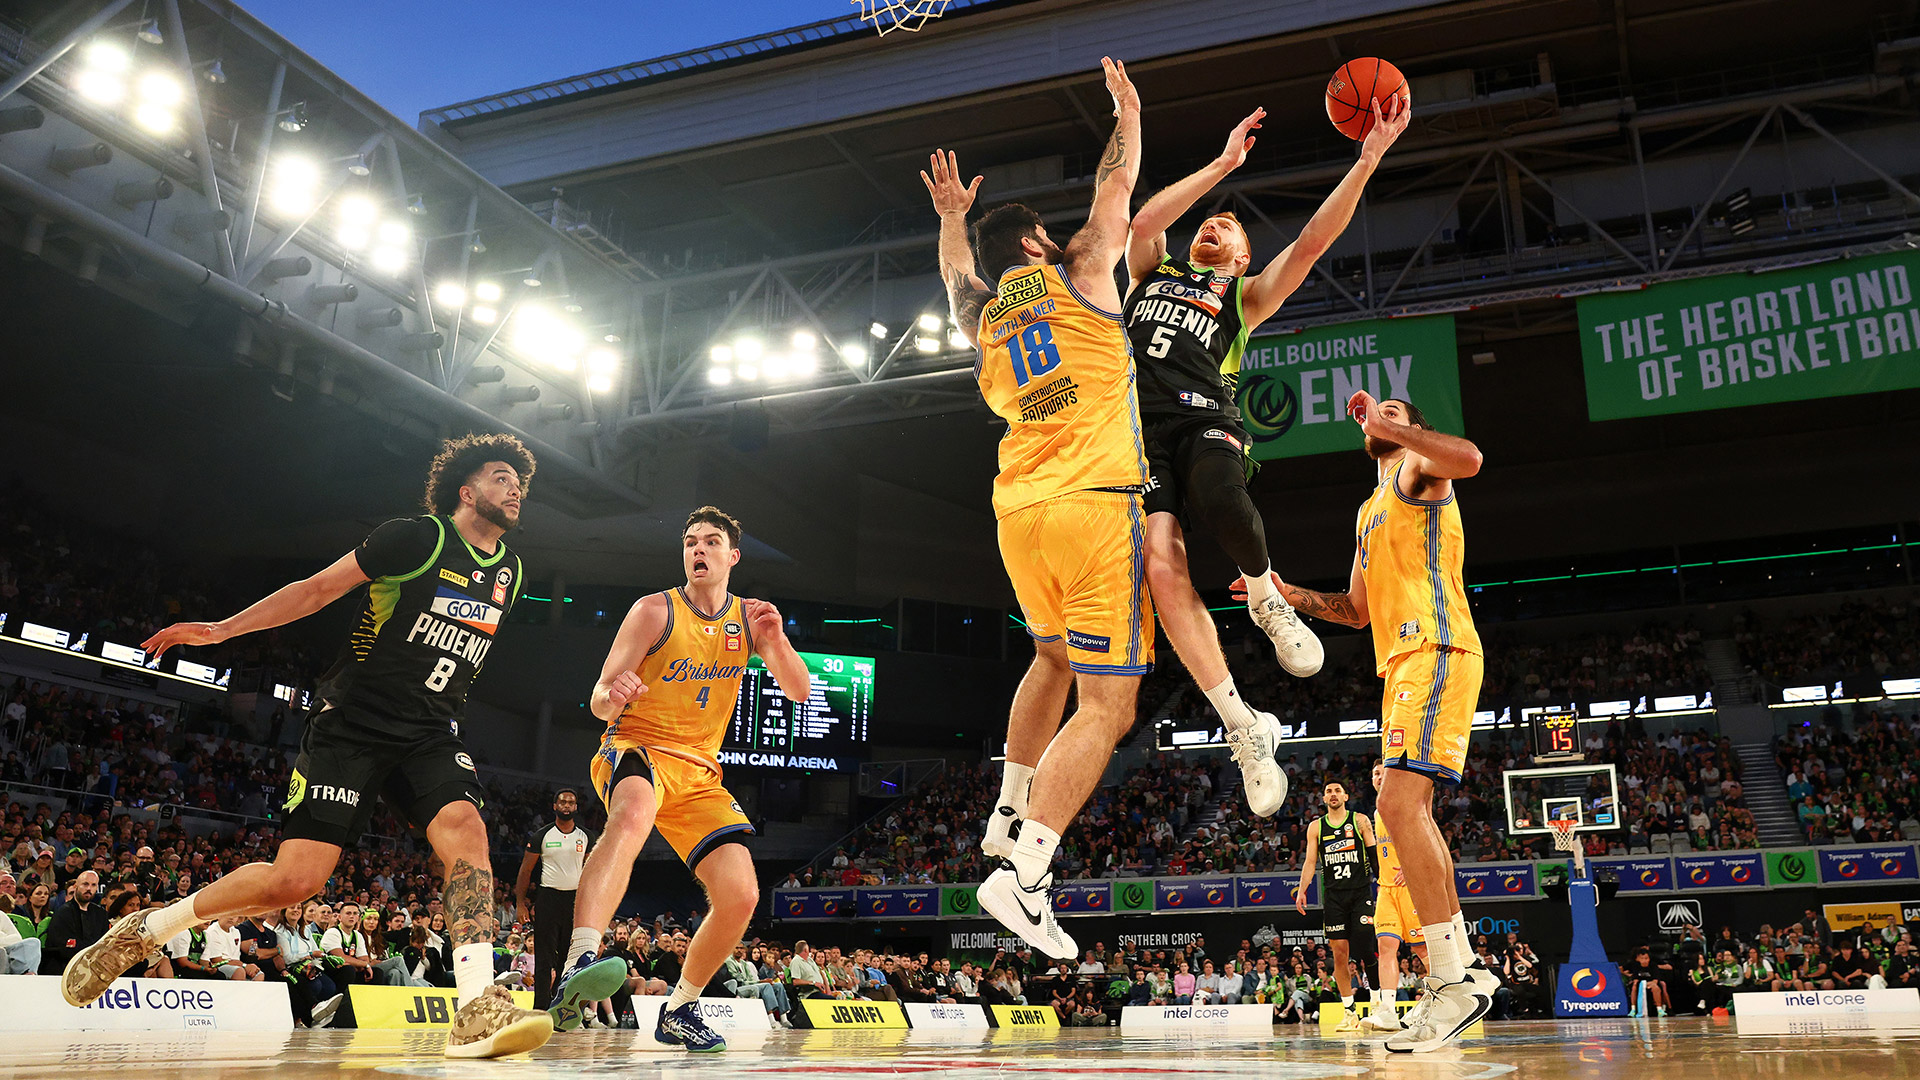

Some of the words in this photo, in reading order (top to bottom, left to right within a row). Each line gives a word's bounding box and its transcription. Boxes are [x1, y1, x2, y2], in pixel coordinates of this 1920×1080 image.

[1000, 275, 1041, 296] IONAL
[1158, 282, 1208, 299] GOAT
[989, 286, 1041, 316] STORAGE
[992, 298, 1057, 342] SMITH-MILNER
[1594, 313, 1668, 363] THE
[1680, 265, 1912, 347] HEARTLAND
[1128, 300, 1220, 350] PHOENIX
[1147, 326, 1177, 359] 5
[1006, 321, 1062, 389] 18
[1241, 334, 1378, 371] MELBOURNE
[1638, 354, 1683, 401] OF
[1018, 375, 1072, 409] CONSTRUCTION
[1021, 391, 1078, 423] PATHWAYS
[442, 571, 467, 585] STANLEY
[446, 601, 490, 620] GOAT
[1070, 633, 1108, 647] Tyrepower
[662, 657, 745, 683] Brisbane
[823, 658, 844, 672] 30
[424, 657, 457, 692] 8
[695, 686, 711, 710] 4
[771, 698, 783, 707] 15
[763, 718, 771, 727] 4
[780, 719, 787, 728] 5
[763, 736, 770, 745] 2
[778, 737, 786, 746] 0
[1552, 728, 1573, 751] 15
[716, 752, 746, 765] OHN
[748, 754, 785, 767] CAIN
[787, 756, 838, 770] ARENA
[1330, 840, 1348, 852] GOAT
[1382, 846, 1388, 858] 8
[1324, 850, 1359, 866] PHOENIX
[1681, 860, 1715, 868] Tyrepower
[1721, 858, 1756, 867] Tyrepower
[1828, 853, 1864, 861] Tyrepower
[1870, 851, 1906, 860] Tyrepower
[1333, 864, 1352, 880] 24
[1458, 871, 1490, 879] Tyrepower
[1495, 869, 1528, 877] Tyrepower
[1631, 863, 1665, 871] Tyrepower
[1080, 886, 1108, 894] Tyrepower
[1160, 884, 1189, 892] Tyrepower
[1200, 882, 1229, 891] Tyrepower
[1241, 880, 1271, 889] Tyrepower
[1835, 913, 1865, 922] William
[1868, 912, 1894, 921] Adam
[1904, 908, 1920, 921] CA
[1464, 916, 1520, 935] orOne
[951, 932, 997, 949] WELCOME
[1118, 933, 1169, 946] SOUTHERN
[1283, 937, 1296, 945] AND
[1785, 992, 1820, 1006] intel
[405, 996, 450, 1024] JB
[928, 1005, 947, 1019] intel
[1163, 1007, 1193, 1018] intel
[1561, 1000, 1621, 1013] Tyrepower
[831, 1006, 851, 1023] JB
[1010, 1010, 1025, 1024] JB
[188, 1018, 212, 1027] ULTRA
